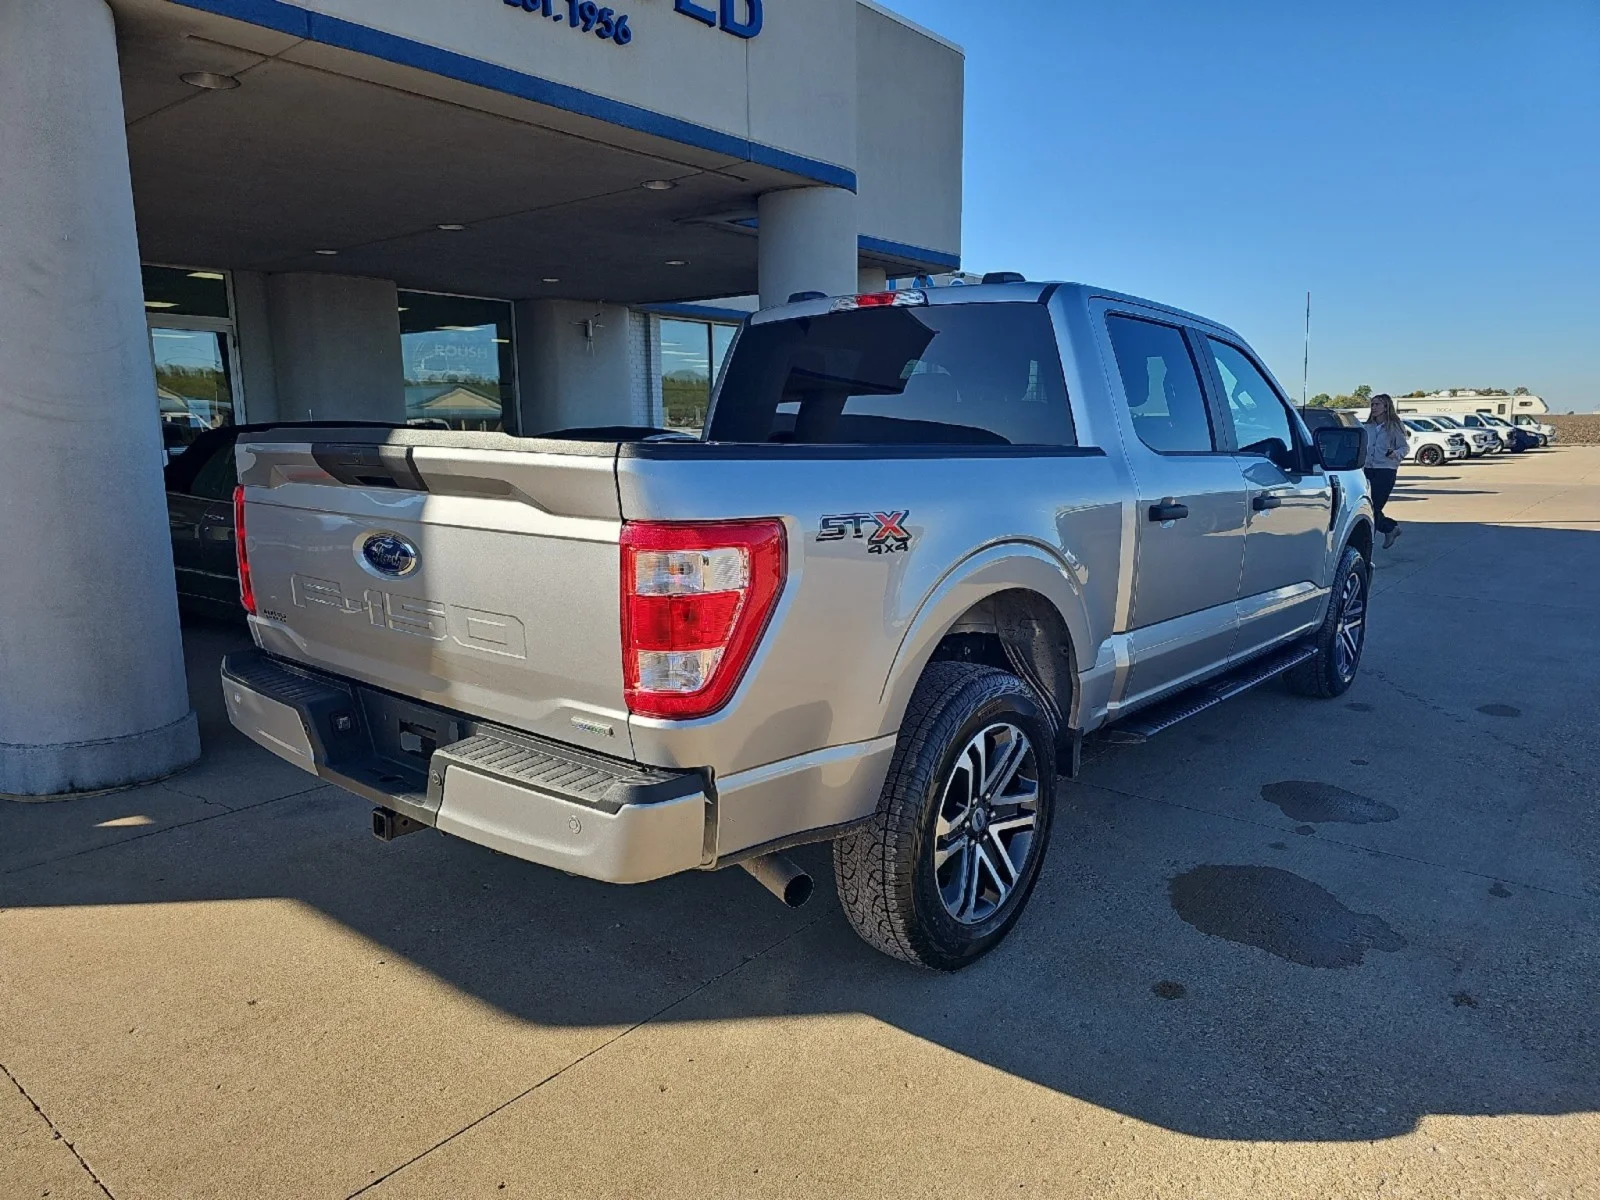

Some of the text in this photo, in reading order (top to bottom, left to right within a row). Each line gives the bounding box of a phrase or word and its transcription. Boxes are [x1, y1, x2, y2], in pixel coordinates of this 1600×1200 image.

[503, 0, 632, 46] .1956
[816, 510, 912, 545] STX
[370, 541, 402, 567] Ford
[290, 572, 528, 660] F-150
